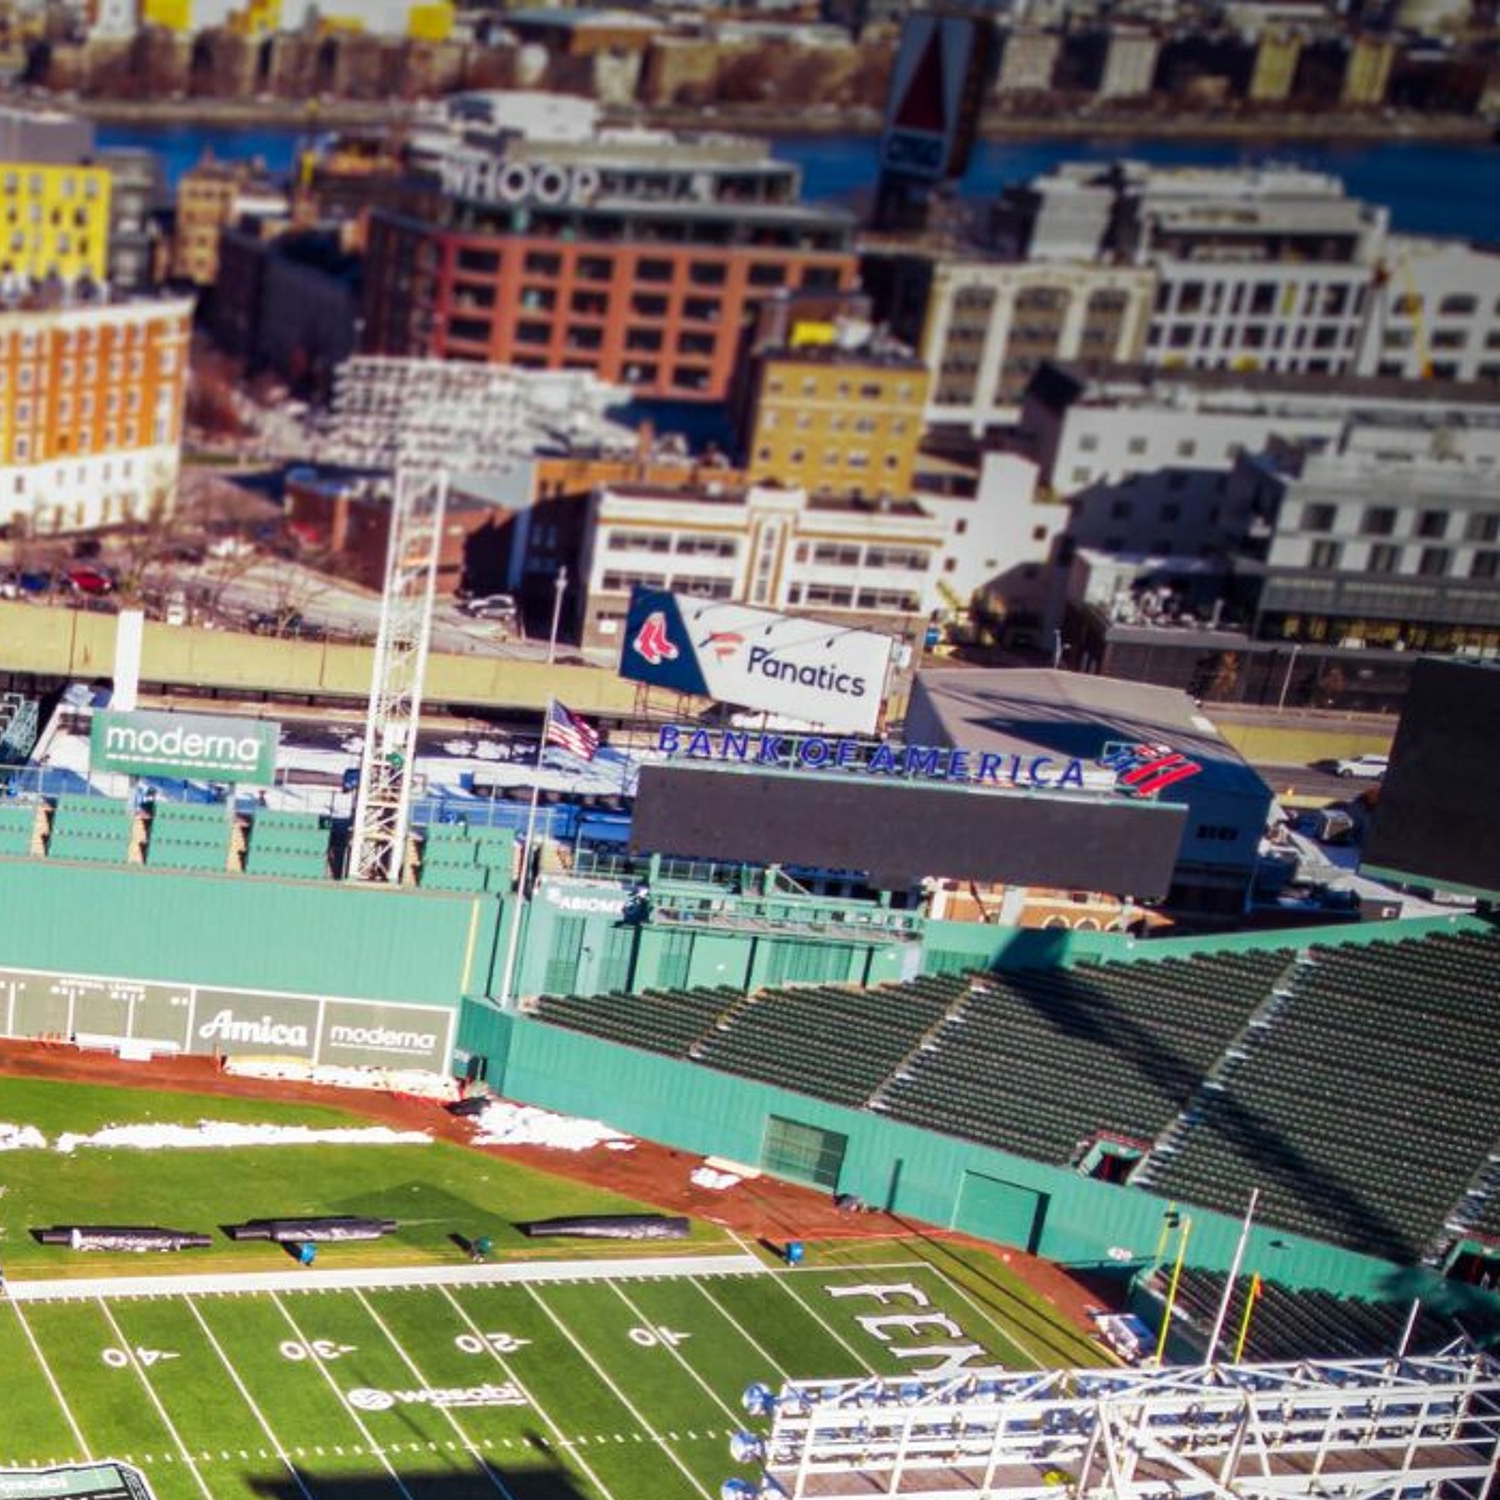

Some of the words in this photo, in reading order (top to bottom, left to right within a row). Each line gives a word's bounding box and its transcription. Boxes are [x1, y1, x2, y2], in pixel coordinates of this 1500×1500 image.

[106, 726, 260, 761] moderna
[659, 724, 784, 763] BANK
[800, 735, 860, 768] OF
[868, 744, 1085, 788] AMERICA
[199, 1009, 308, 1046] Amica
[330, 1024, 438, 1049] moderna
